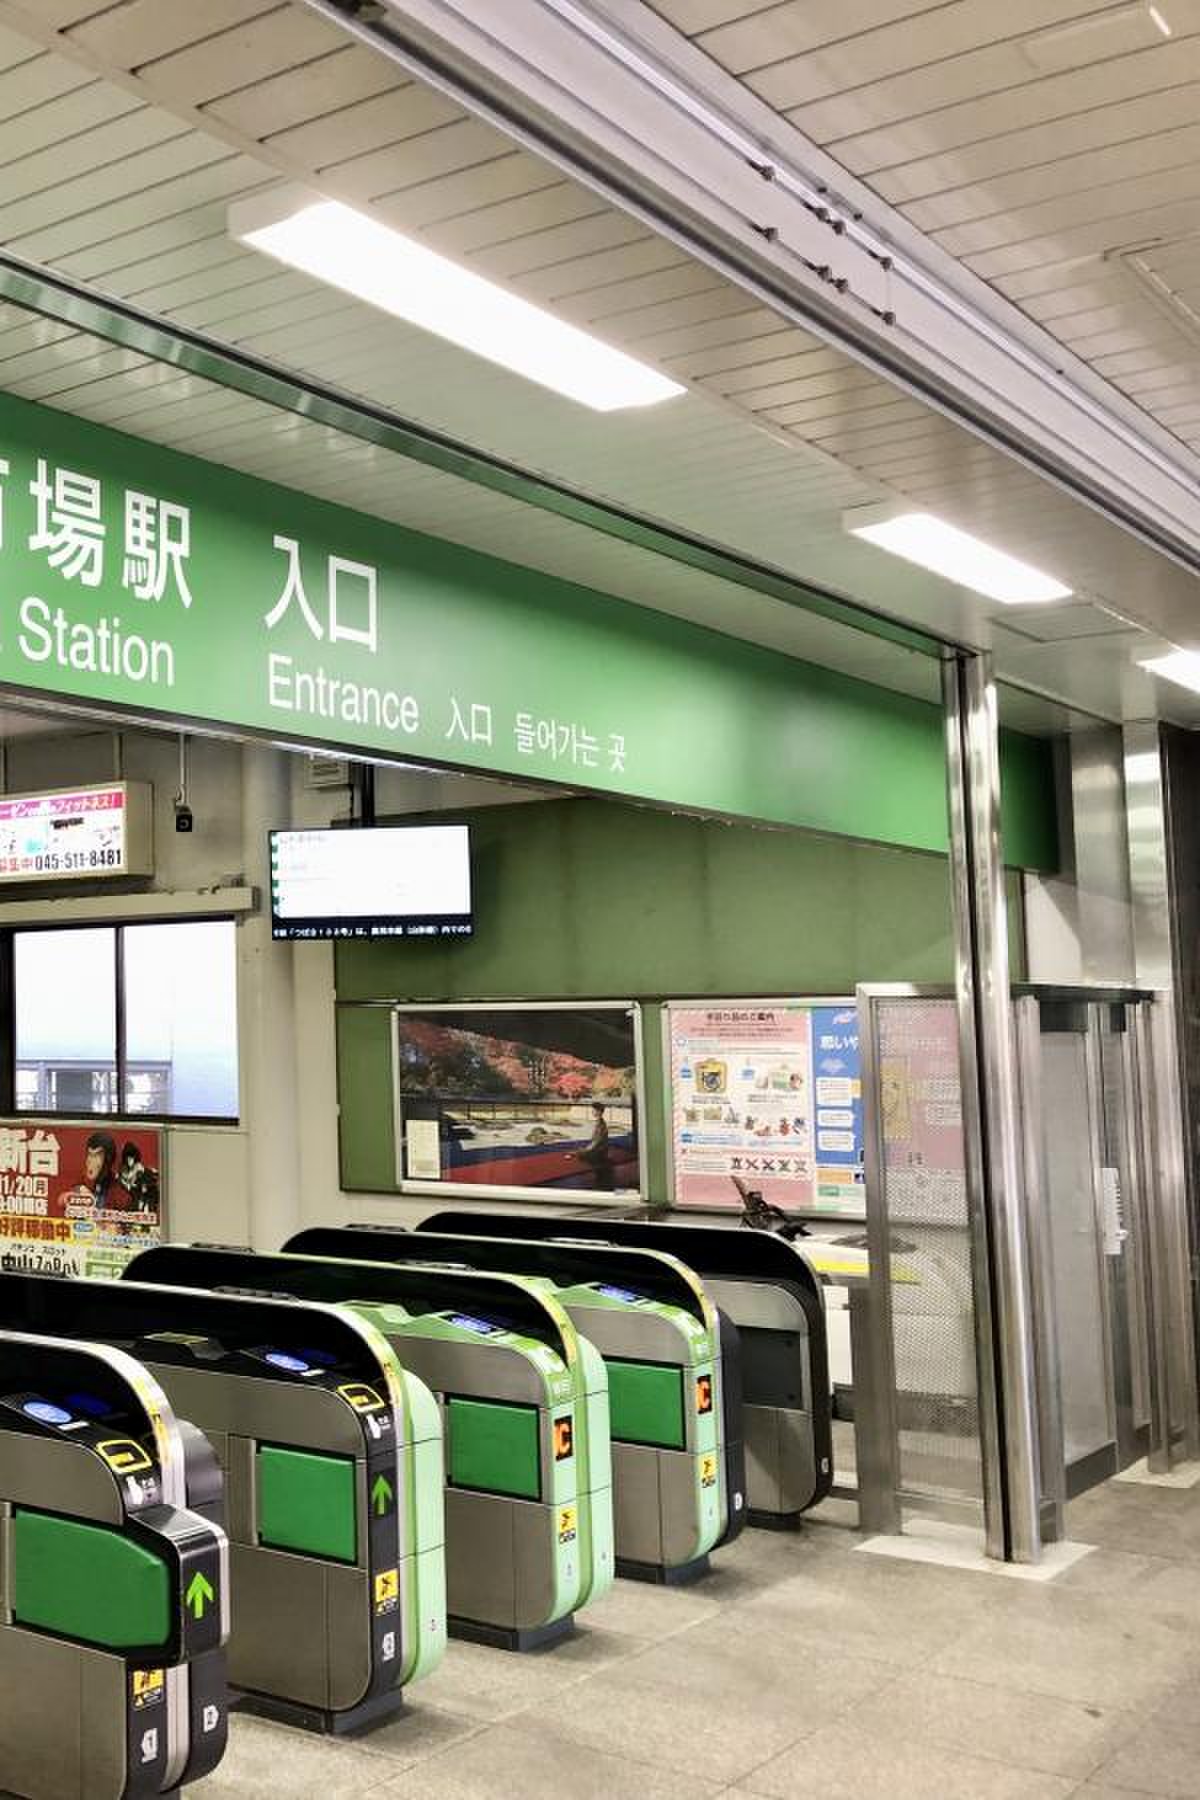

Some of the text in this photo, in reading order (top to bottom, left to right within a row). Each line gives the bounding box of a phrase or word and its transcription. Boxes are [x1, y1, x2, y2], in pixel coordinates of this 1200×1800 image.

[264, 534, 377, 652] 入口
[17, 596, 174, 687] Station
[268, 652, 419, 733] Entrance
[444, 697, 492, 746] 入口
[514, 713, 628, 773] 들어가는 곳
